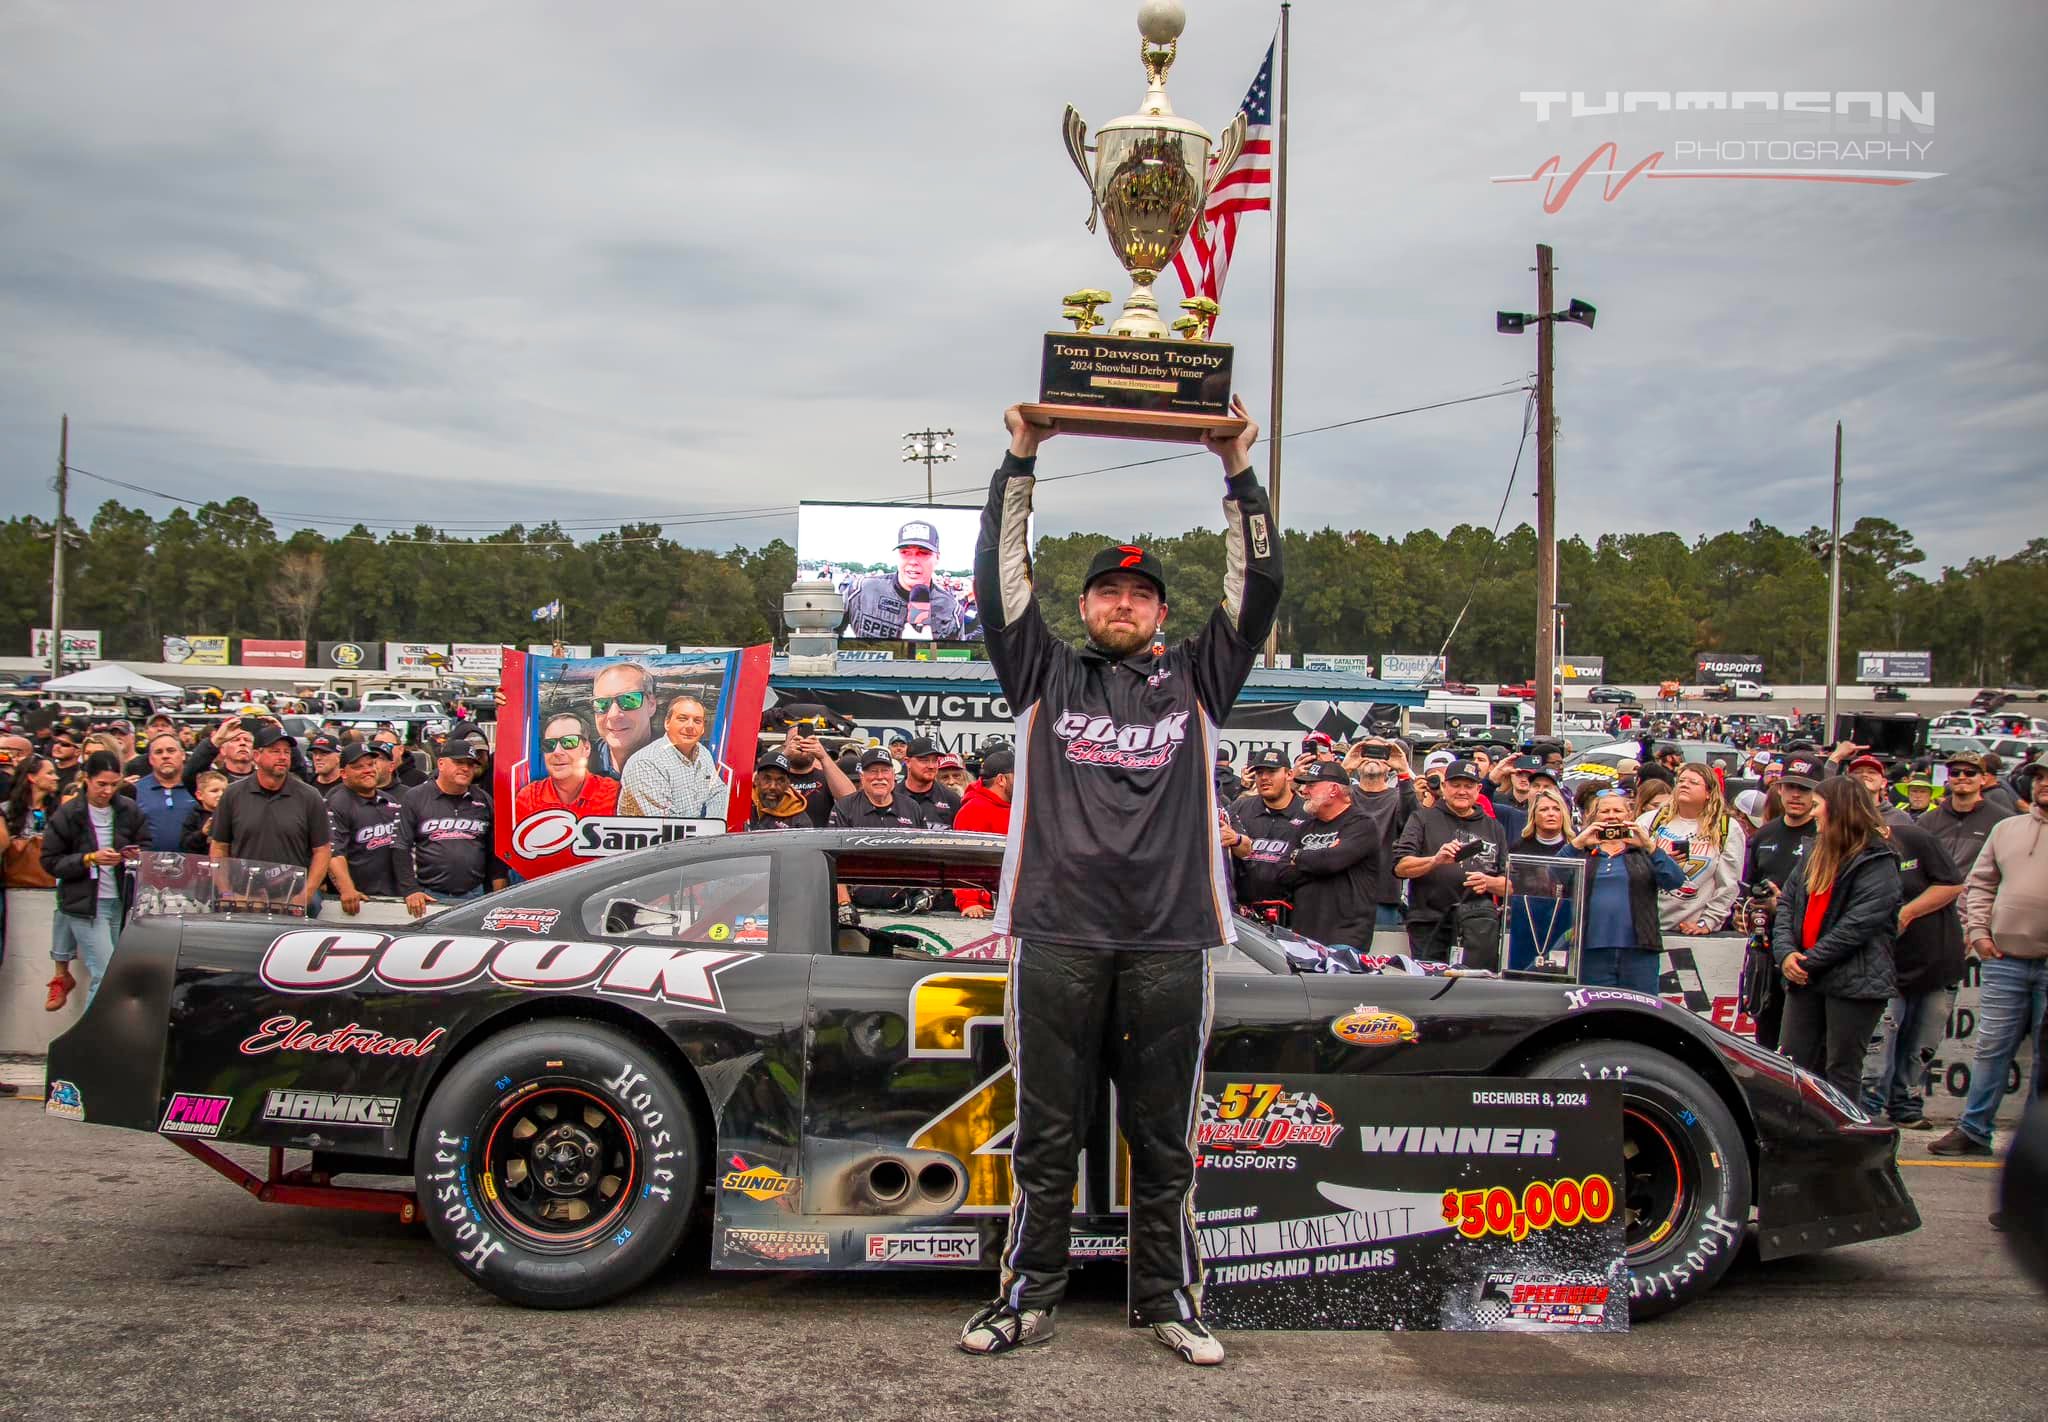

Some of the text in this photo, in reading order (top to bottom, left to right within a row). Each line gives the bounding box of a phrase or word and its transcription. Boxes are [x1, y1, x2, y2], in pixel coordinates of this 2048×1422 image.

[1053, 344, 1223, 368] Tom Dawson Trophy
[1070, 361, 1204, 379] 2024 Snowball Derby Winner
[1704, 662, 1762, 673] FLOSPORTS
[1055, 711, 1189, 750] COOK
[261, 930, 760, 1010] COOK
[1587, 991, 1657, 1007] HOOSIER
[240, 1015, 447, 1057] Electrical
[1343, 1023, 1398, 1034] SUPER
[1218, 1083, 1282, 1119] 57
[1473, 1092, 1587, 1107] DECEMBER 8, 2024
[163, 1120, 218, 1134] Carburetors
[600, 1064, 684, 1202] Hoosier
[1262, 1117, 1343, 1147] DERBY
[1360, 1126, 1555, 1154] WINNER
[1204, 1155, 1297, 1169] FLOSPORTS
[426, 1129, 505, 1270] Hoosier
[1207, 1207, 1242, 1221] ORDER
[1243, 1206, 1258, 1217] OF
[1440, 1173, 1614, 1242] $50,000
[887, 1235, 977, 1256] FACTORY
[1198, 1207, 1416, 1259] ADEN HONEYCUTT
[1216, 1257, 1309, 1284] THOUSAND
[1315, 1249, 1395, 1272] DOLLARS
